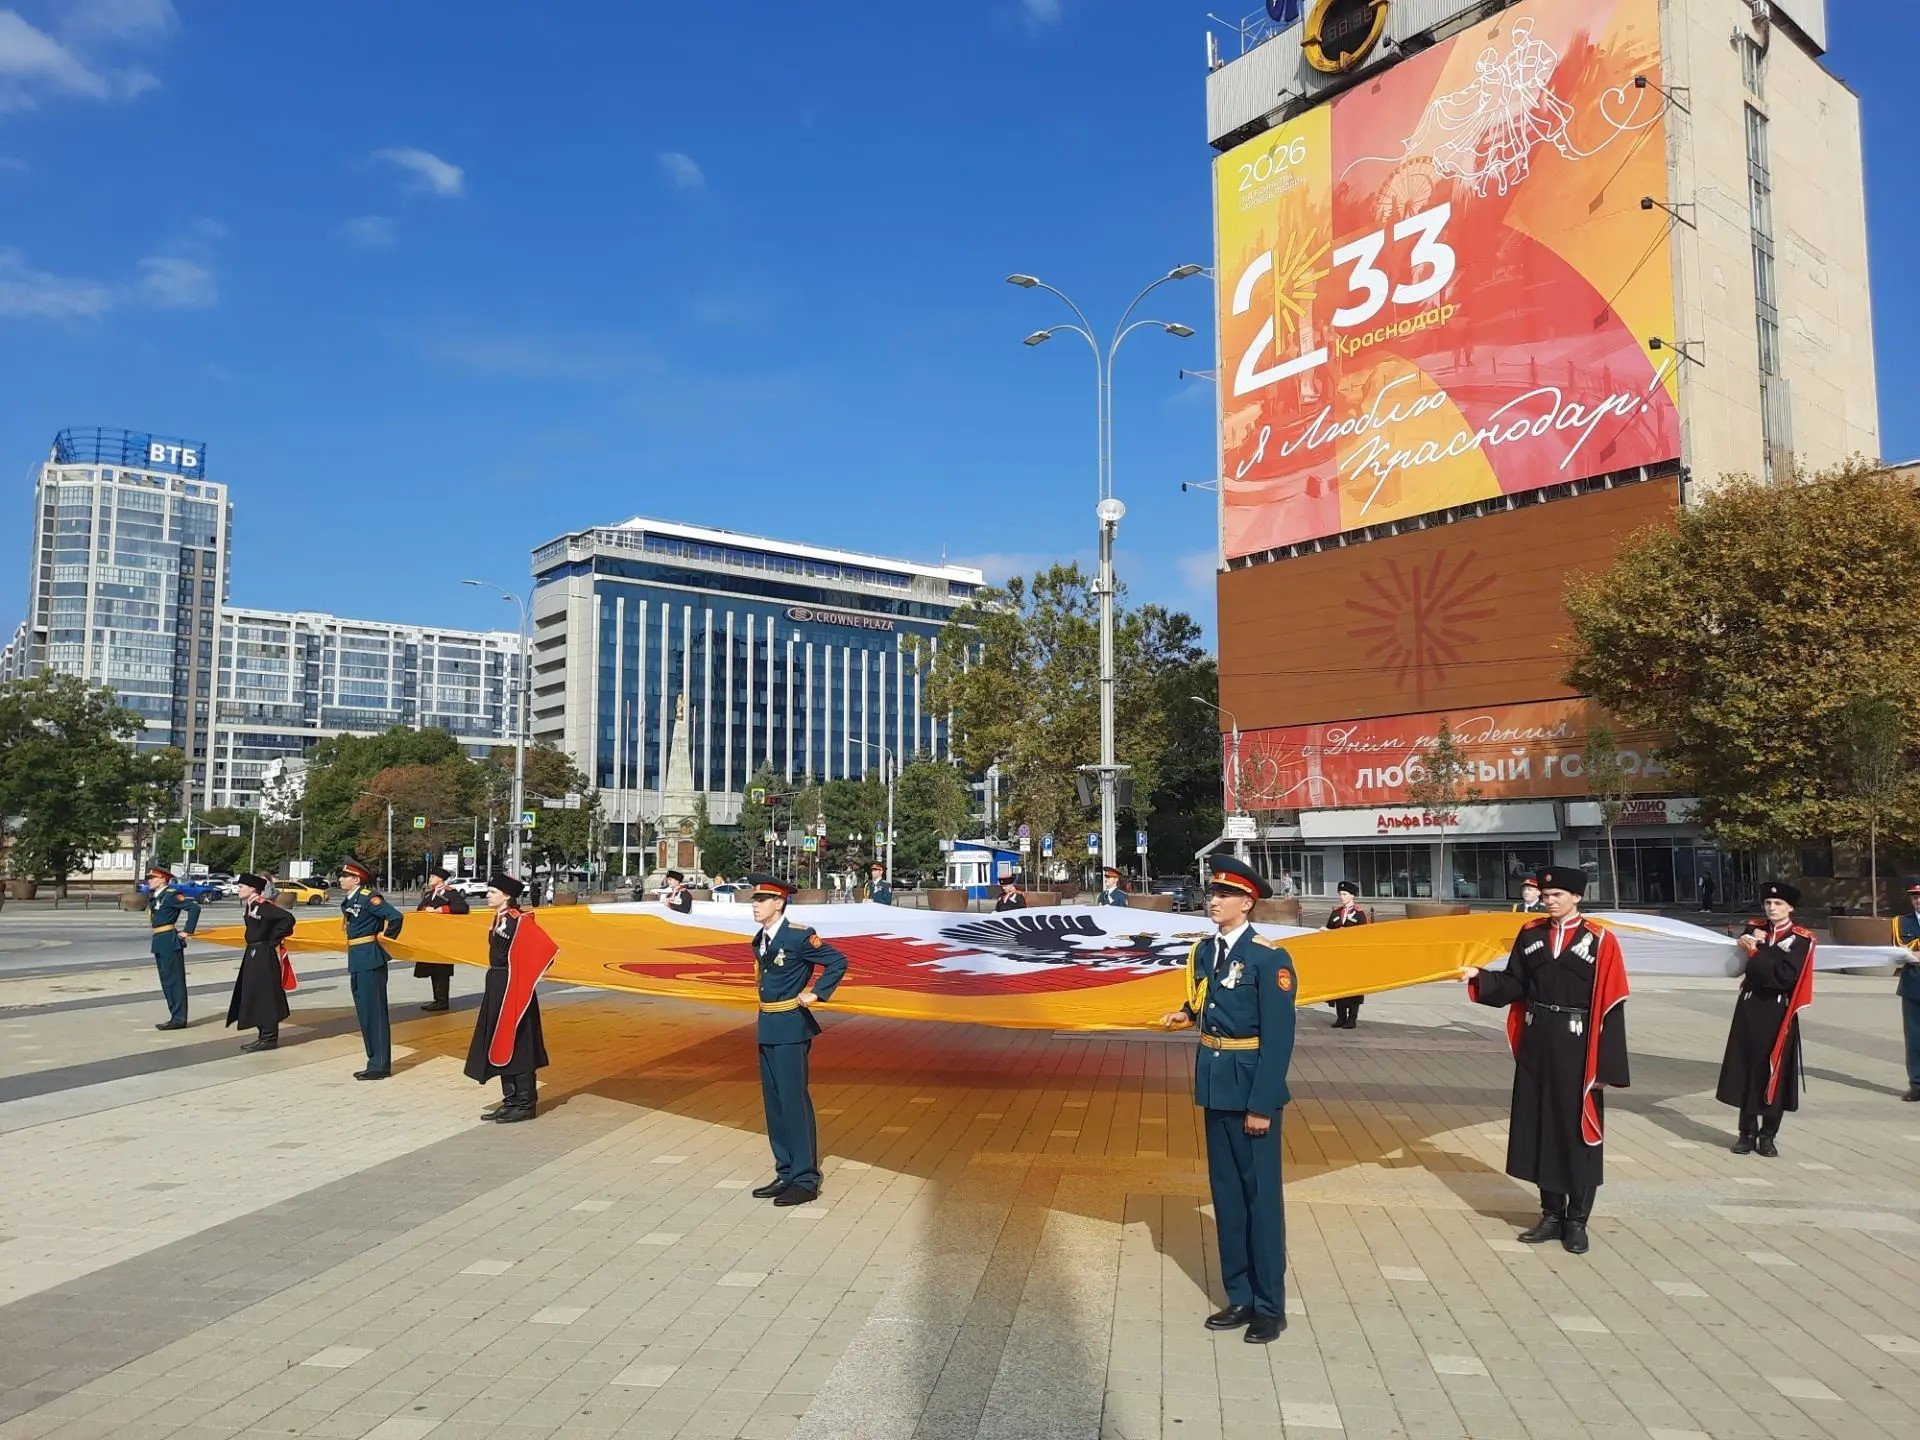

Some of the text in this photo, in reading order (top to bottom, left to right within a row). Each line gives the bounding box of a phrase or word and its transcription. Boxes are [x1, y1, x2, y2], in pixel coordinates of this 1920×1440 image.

[1238, 136, 1306, 192] 2026
[1335, 302, 1455, 357] Краснодар
[1236, 373, 1448, 479] Я Люблю
[1339, 357, 1671, 516] Краснодар!
[151, 443, 197, 467] ВТБ
[816, 611, 895, 631] CROWNE PLAZA
[1377, 814, 1421, 832] Альфа
